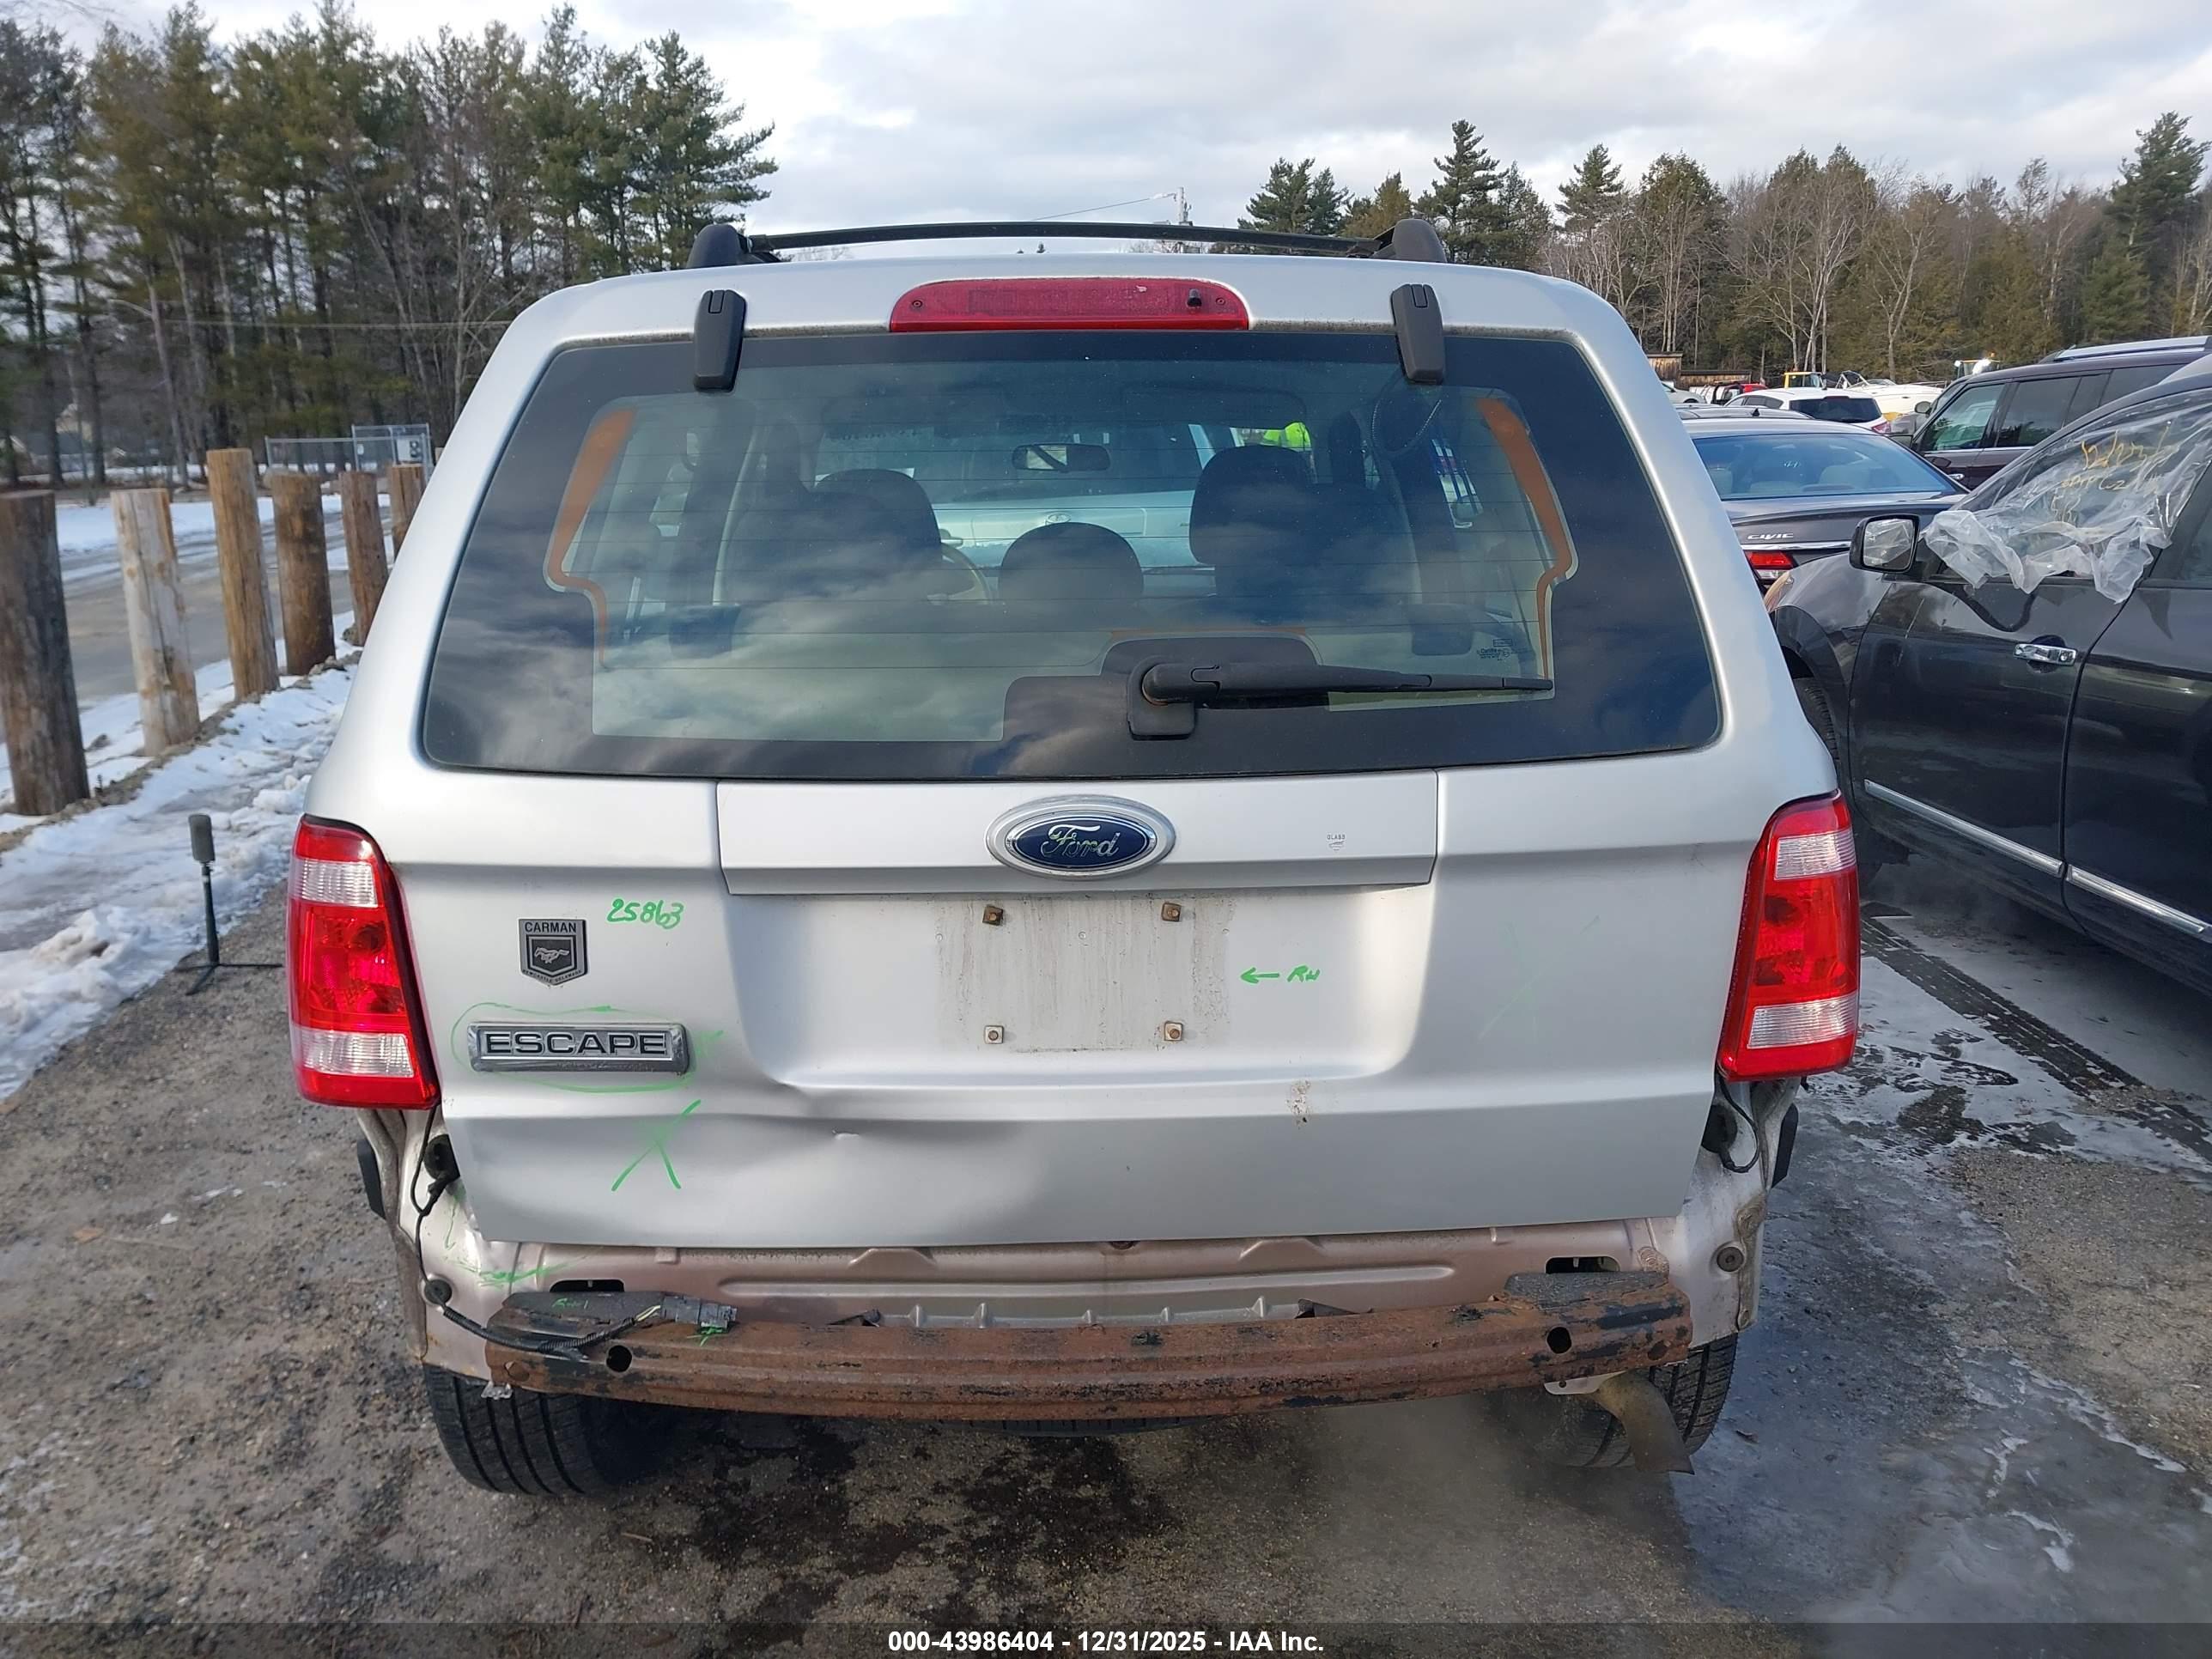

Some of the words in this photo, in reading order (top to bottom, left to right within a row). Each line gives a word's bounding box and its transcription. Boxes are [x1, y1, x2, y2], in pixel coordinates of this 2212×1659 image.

[1040, 823, 1121, 858] Ford
[525, 921, 577, 933] CARMAN
[606, 898, 684, 930] 25863
[484, 1031, 667, 1055] ESCAPE
